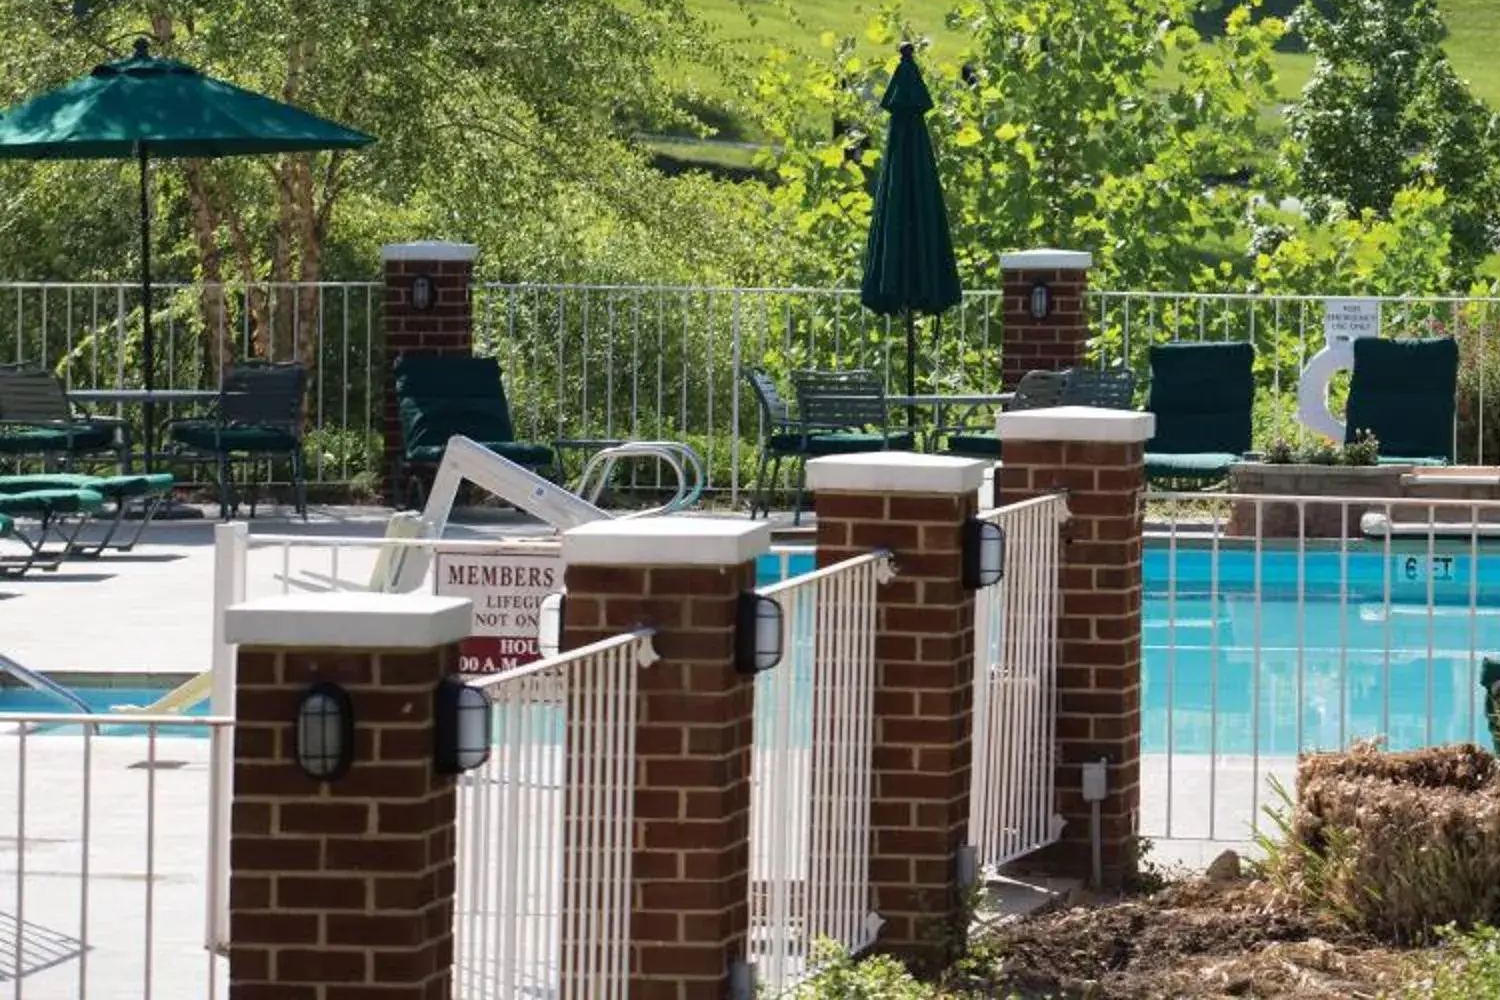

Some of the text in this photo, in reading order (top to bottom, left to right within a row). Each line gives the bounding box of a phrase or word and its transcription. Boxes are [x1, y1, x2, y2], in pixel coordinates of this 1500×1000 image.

[448, 565, 555, 588] MEMBERS
[1405, 557, 1417, 580] 6
[475, 613, 507, 627] NOT
